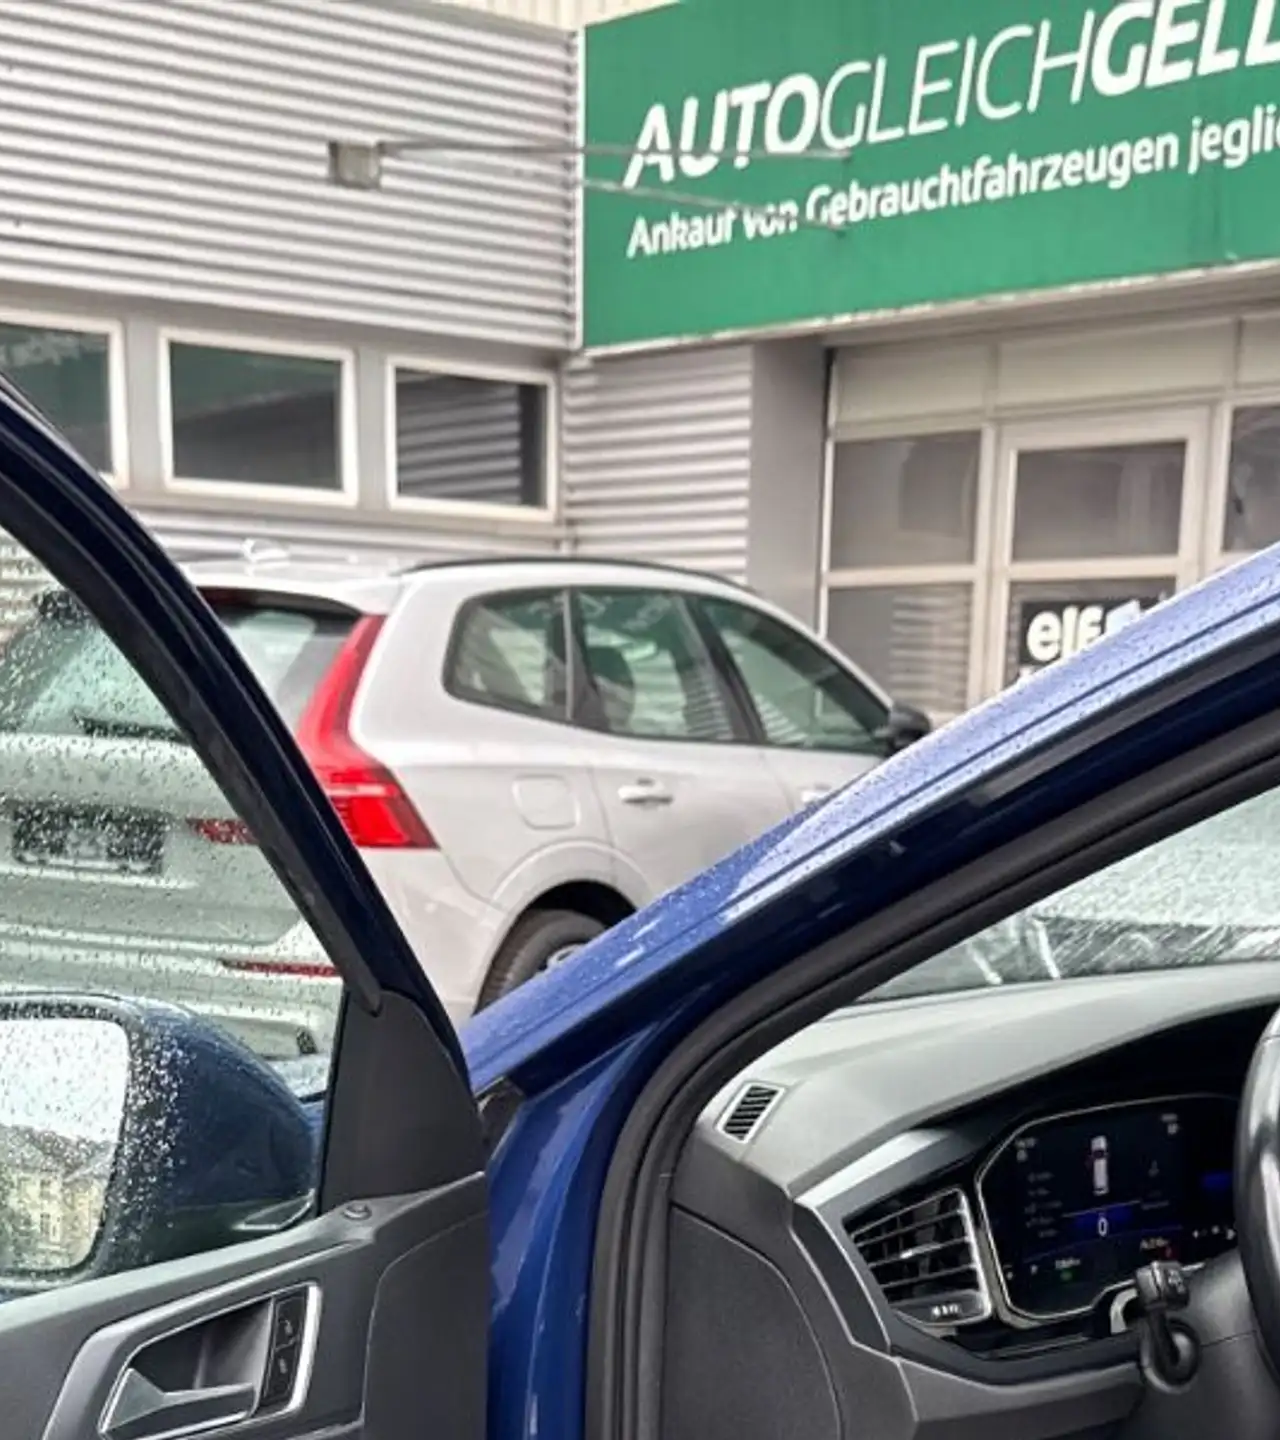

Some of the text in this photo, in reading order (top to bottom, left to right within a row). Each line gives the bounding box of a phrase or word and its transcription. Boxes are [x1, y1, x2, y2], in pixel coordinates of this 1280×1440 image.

[626, 206, 737, 258] Ankauf
[742, 202, 799, 240] von
[806, 134, 1179, 226] Gebrauchtfahrzeugen
